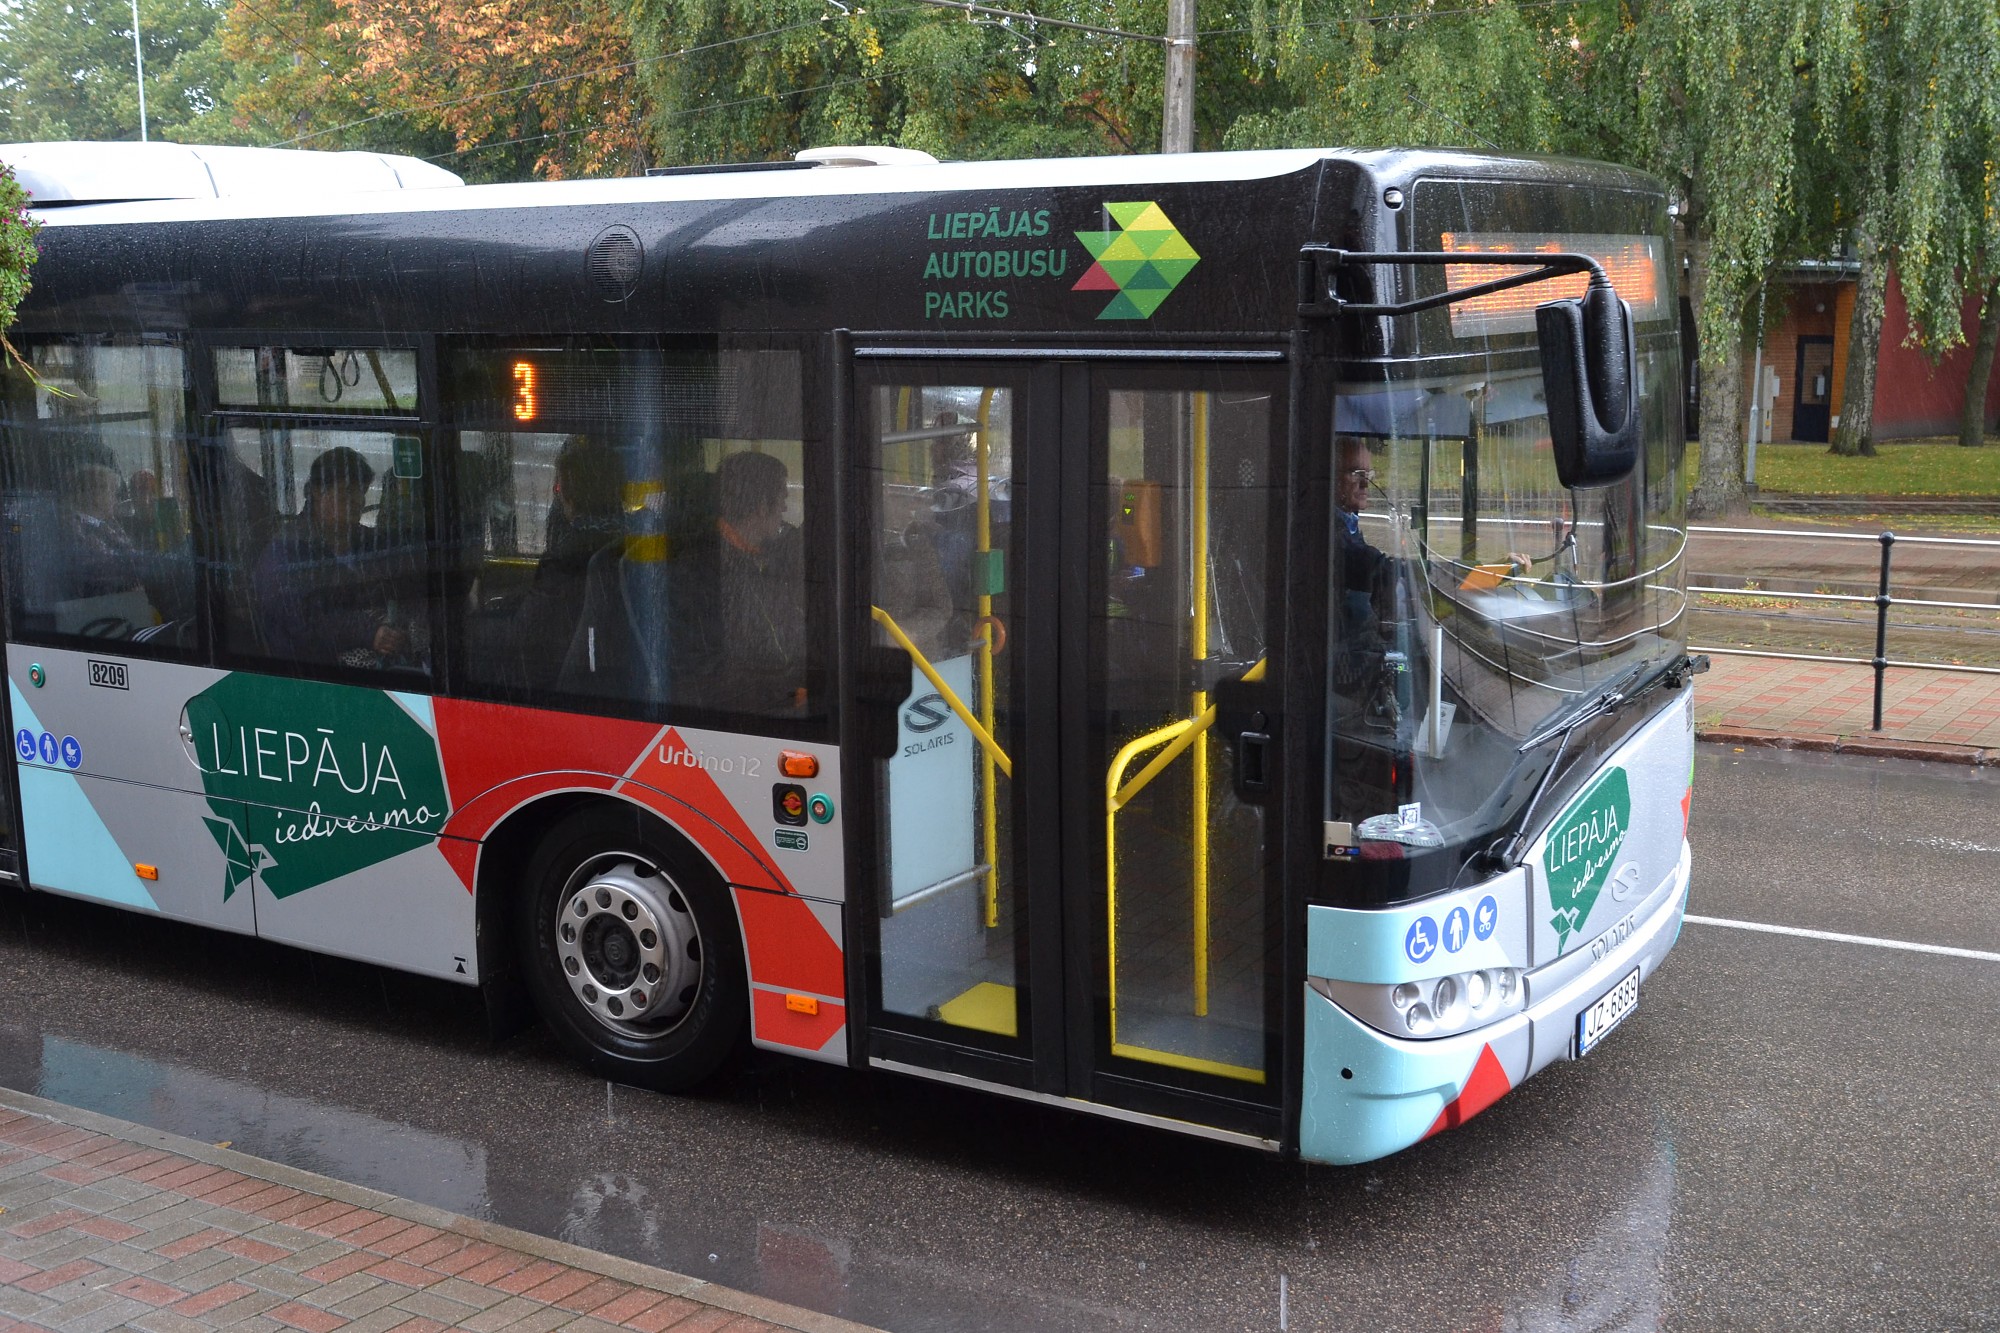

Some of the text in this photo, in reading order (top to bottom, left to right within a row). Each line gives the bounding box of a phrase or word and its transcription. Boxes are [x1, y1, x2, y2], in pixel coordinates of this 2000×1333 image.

[927, 206, 1051, 240] LIEPĀJAS
[922, 249, 1067, 279] AUTOBUSU
[925, 290, 1009, 319] PARKS
[512, 362, 535, 421] 3
[92, 663, 125, 687] 8209
[212, 721, 407, 801] LIEPĀJA
[658, 743, 761, 778] Urbino 12
[903, 732, 955, 758] SOLARIS
[274, 800, 441, 844] iedvesmo
[1550, 804, 1619, 873] LIEPĀJA
[1571, 829, 1627, 899] iedvesmo
[1591, 914, 1636, 961] SOLARIS
[1588, 974, 1637, 1038] JZ-6889
